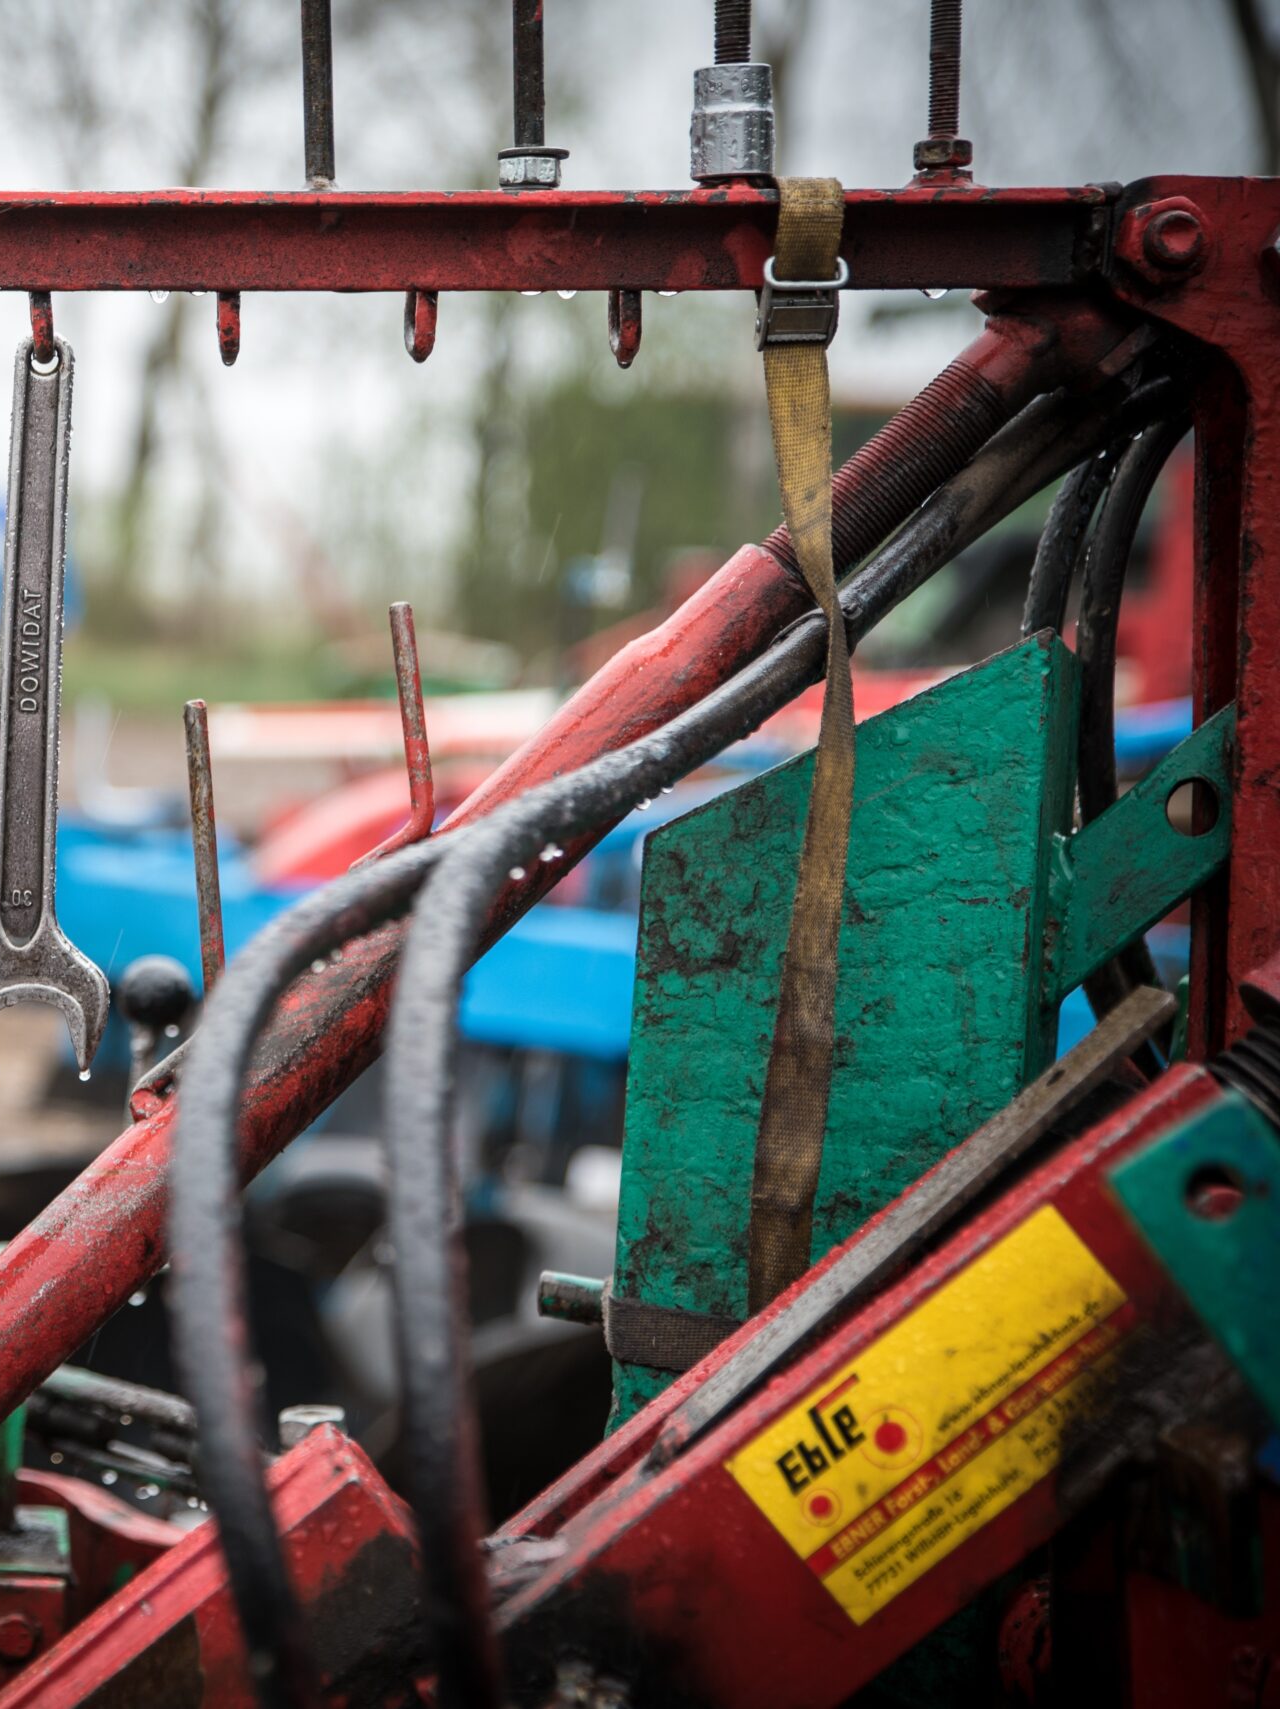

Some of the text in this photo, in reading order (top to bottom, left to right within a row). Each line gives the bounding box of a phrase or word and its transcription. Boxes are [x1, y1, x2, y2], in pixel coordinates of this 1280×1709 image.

[20, 589, 41, 712] DOWIDAT
[12, 889, 33, 907] 30
[775, 1400, 866, 1496] Eble
[830, 1508, 888, 1560] EBNER
[985, 1413, 1007, 1436] &
